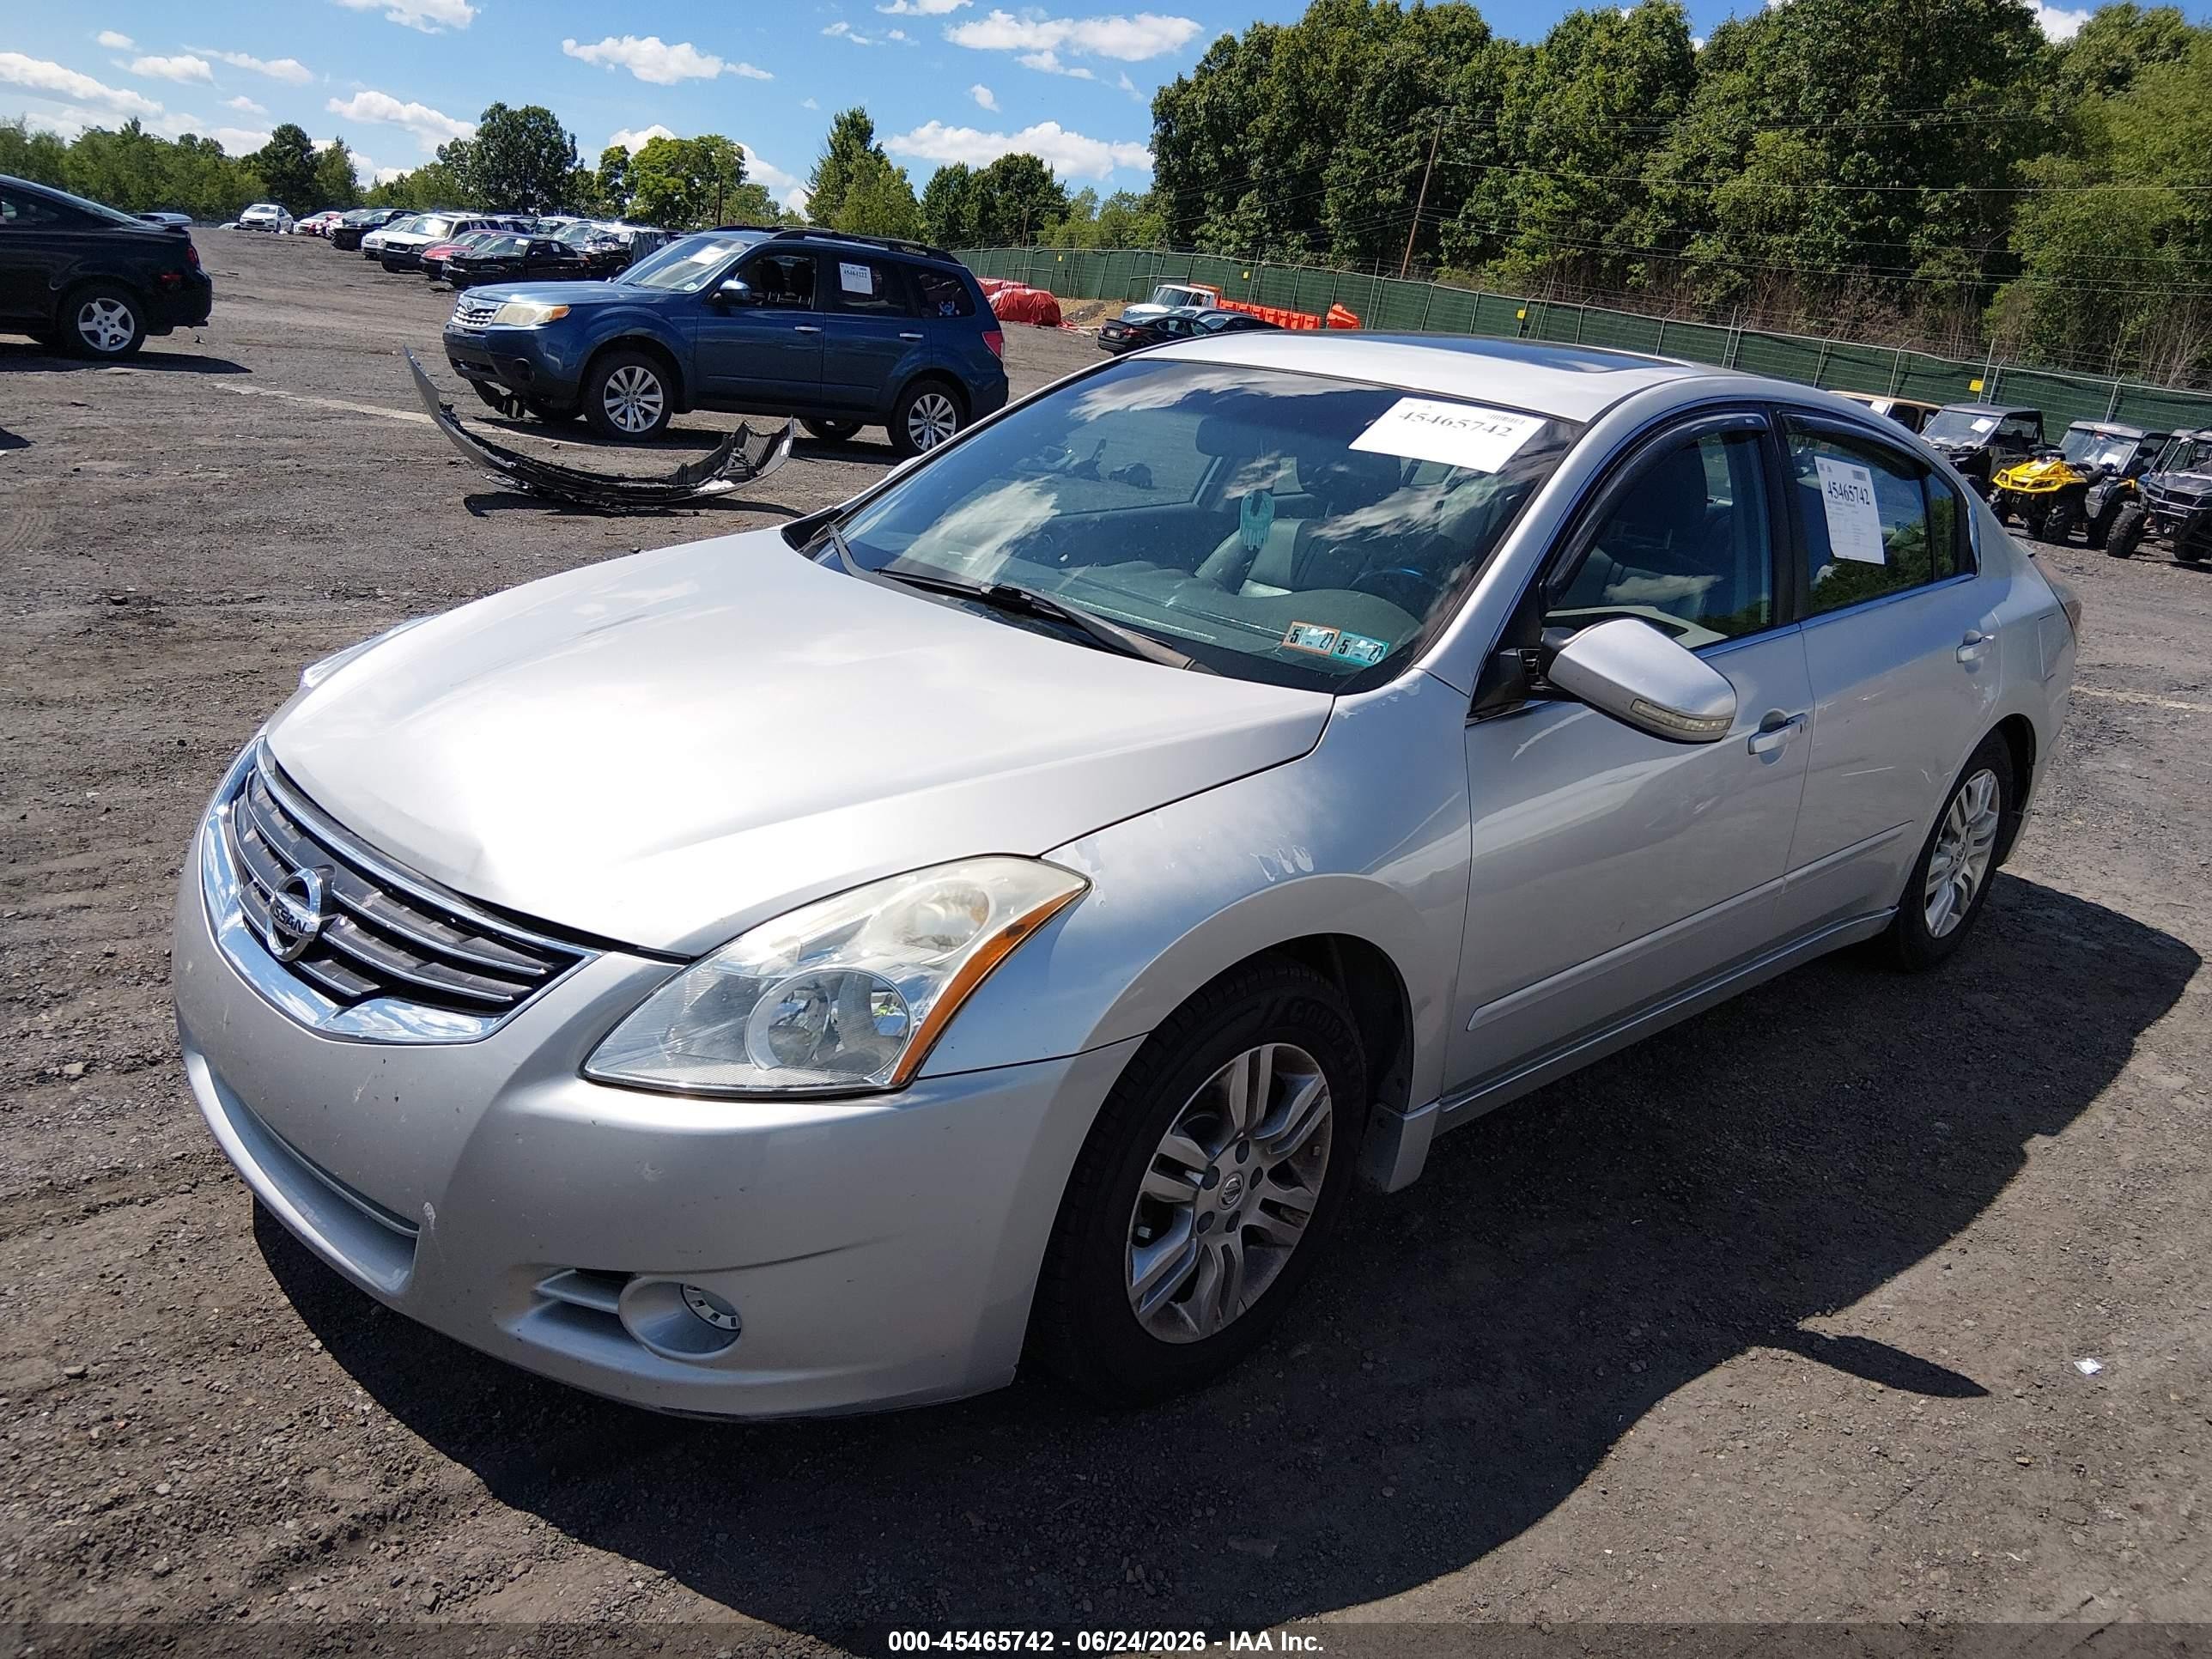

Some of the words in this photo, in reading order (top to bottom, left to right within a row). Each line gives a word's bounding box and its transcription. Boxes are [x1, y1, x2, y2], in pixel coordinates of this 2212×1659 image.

[1399, 411, 1513, 436] 45465742
[1827, 480, 1870, 506] 45465742
[1289, 629, 1301, 644] 5
[1338, 639, 1351, 654] 5
